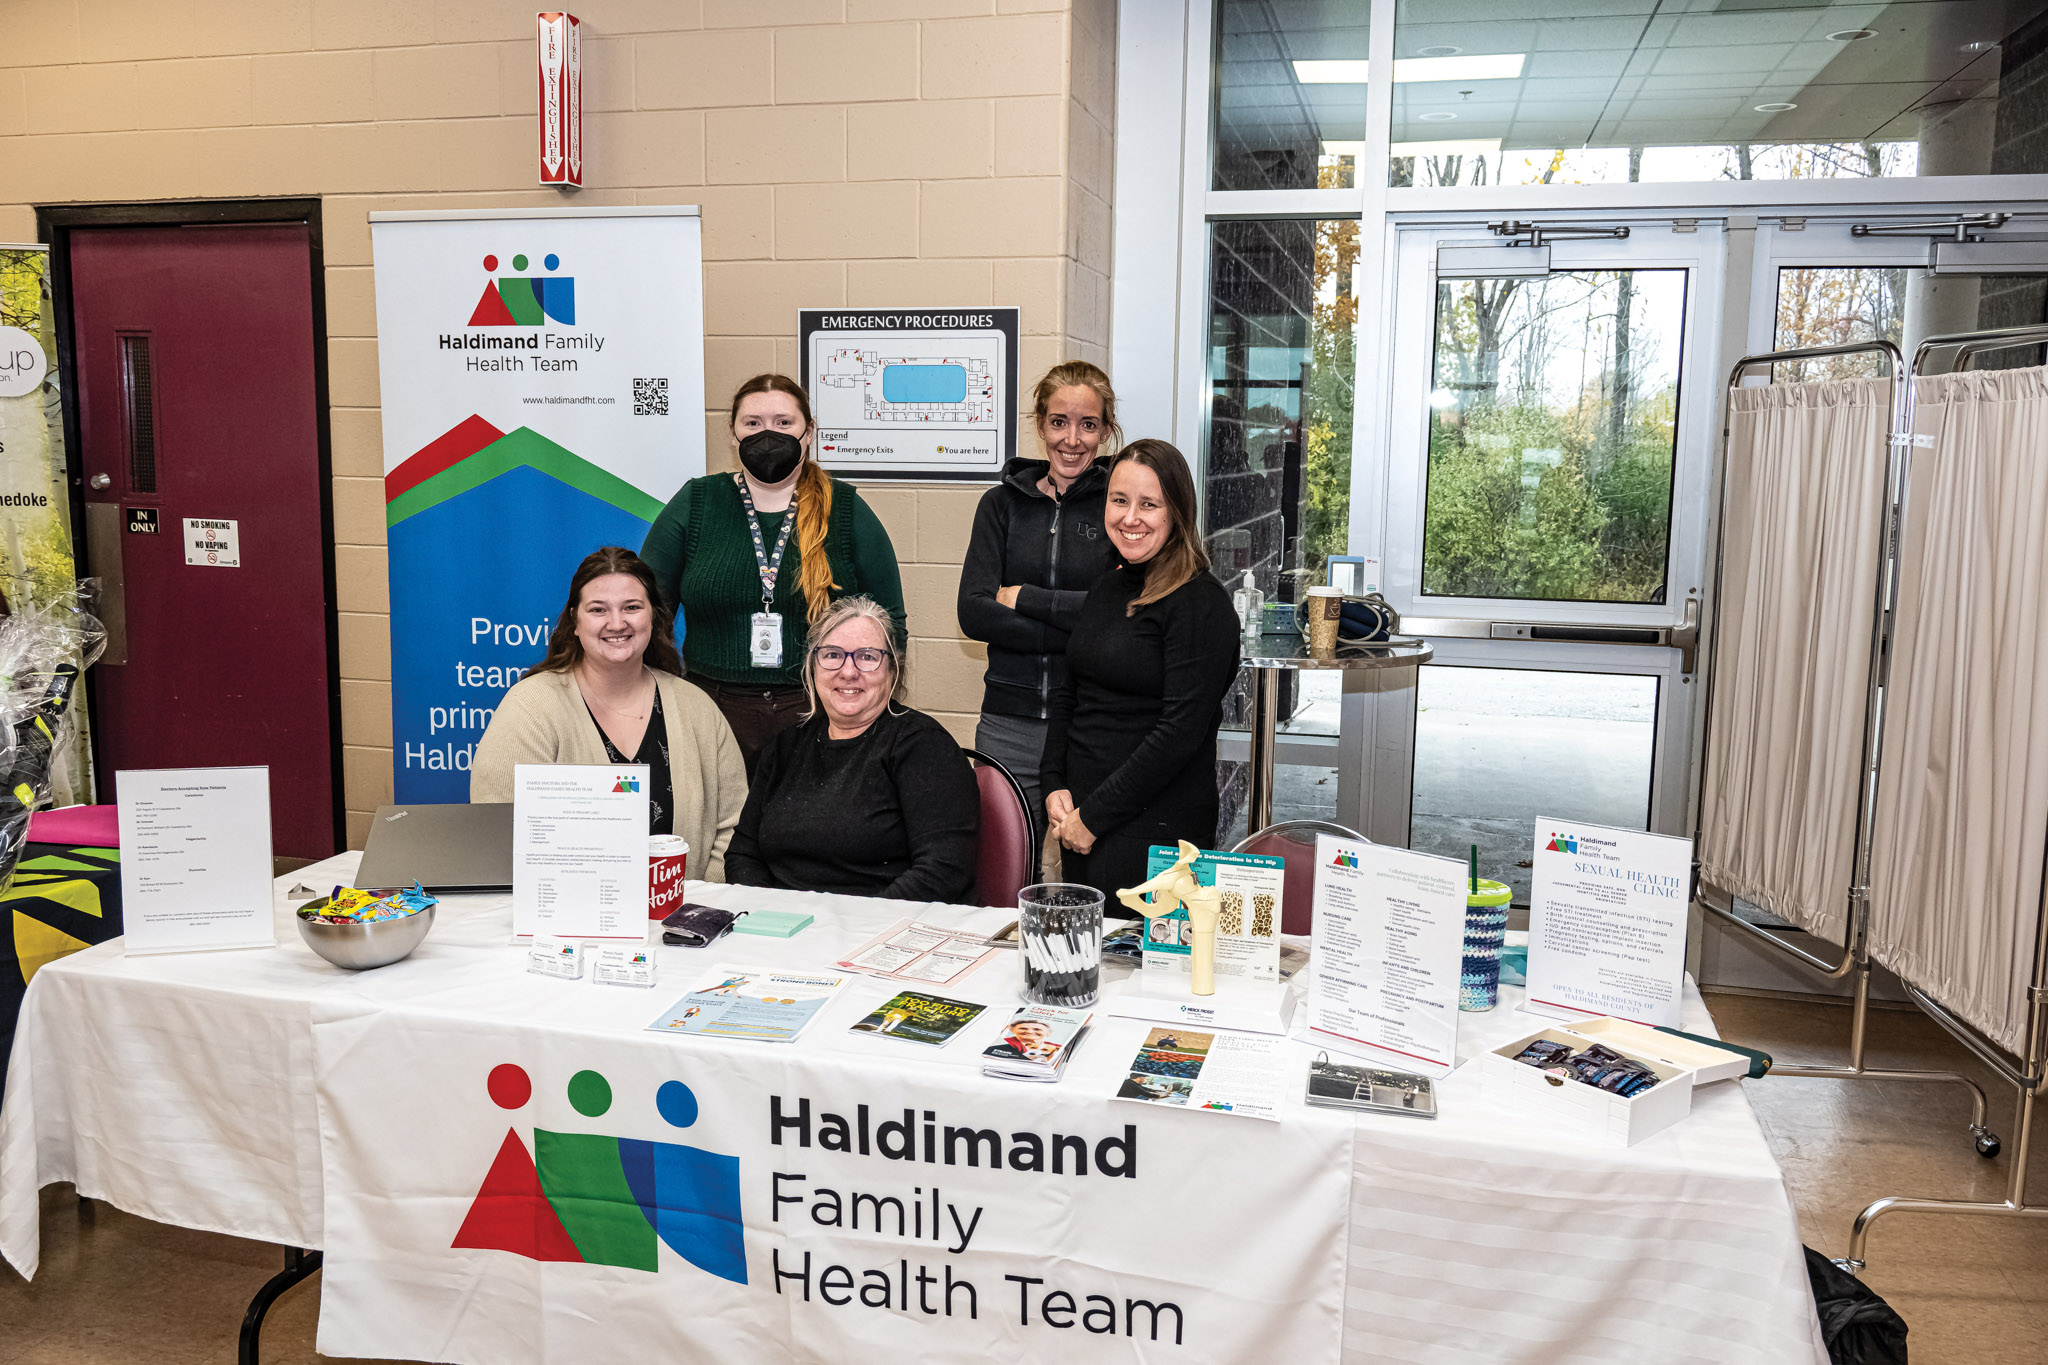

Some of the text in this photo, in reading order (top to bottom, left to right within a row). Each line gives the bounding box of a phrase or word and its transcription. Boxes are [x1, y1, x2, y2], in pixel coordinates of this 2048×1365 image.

[548, 68, 558, 164] EXTINGUISHER
[822, 315, 993, 328] EMERGENCY PROCEDURES
[439, 333, 604, 352] Haldimand Family
[466, 356, 578, 372] Health Team
[522, 396, 615, 405] www.haldimandfht.com
[821, 432, 848, 440] Legend
[837, 446, 875, 455] Emergency
[137, 511, 147, 520] IN
[130, 522, 156, 533] ONLY
[201, 521, 230, 529] SMOKING
[1078, 522, 1097, 539] UG
[471, 617, 550, 646] Provi
[456, 661, 530, 688] team
[430, 701, 496, 735] prim
[1579, 843, 1601, 852] Family
[1580, 836, 1616, 847] Haldimand
[1204, 854, 1244, 862] Deterioration
[1579, 850, 1620, 861] Health Team
[649, 859, 681, 885] Tim
[1574, 861, 1679, 888] SEXUAL HEALTH
[1633, 882, 1679, 899] CLINIC
[1550, 899, 1673, 927] Sexually transmitted infection (STI) testing
[1574, 910, 1602, 919] treatment
[1549, 916, 1578, 927] Emergency
[1580, 922, 1620, 935] contraception
[1621, 930, 1636, 938] (Plan
[1564, 914, 1584, 922] control
[1586, 918, 1618, 929] counselling
[1632, 926, 1667, 938] prescription
[1548, 933, 1588, 946] Immunizations
[1548, 928, 1576, 938] Pregnancy
[1601, 938, 1624, 948] options,
[1638, 945, 1663, 954] referrals
[1572, 926, 1610, 939] contraceptive
[1612, 934, 1633, 943] implant
[1635, 938, 1661, 948] insertion
[1548, 939, 1570, 948] Cervical
[1592, 948, 1619, 958] screening
[1636, 956, 1650, 964] test)
[1561, 947, 1586, 956] condoms
[1409, 966, 1430, 975] CHILDREN
[904, 997, 930, 1006] TOO
[1380, 989, 1404, 999] PREGNANCY
[1415, 997, 1444, 1008] POSTPARTUM
[1553, 983, 1572, 992] OPEN
[1586, 990, 1599, 998] ALL
[1601, 993, 1642, 1007] RESIDENTS
[1564, 992, 1640, 1014] HALDIMAND COUNTY
[898, 1000, 964, 1017] FRACTURE
[1357, 1009, 1368, 1018] Team
[1375, 1014, 1404, 1026] Professionals
[770, 1095, 1137, 1179] Haldimand
[772, 1172, 983, 1254] Family
[773, 1248, 1184, 1345] Health Team
